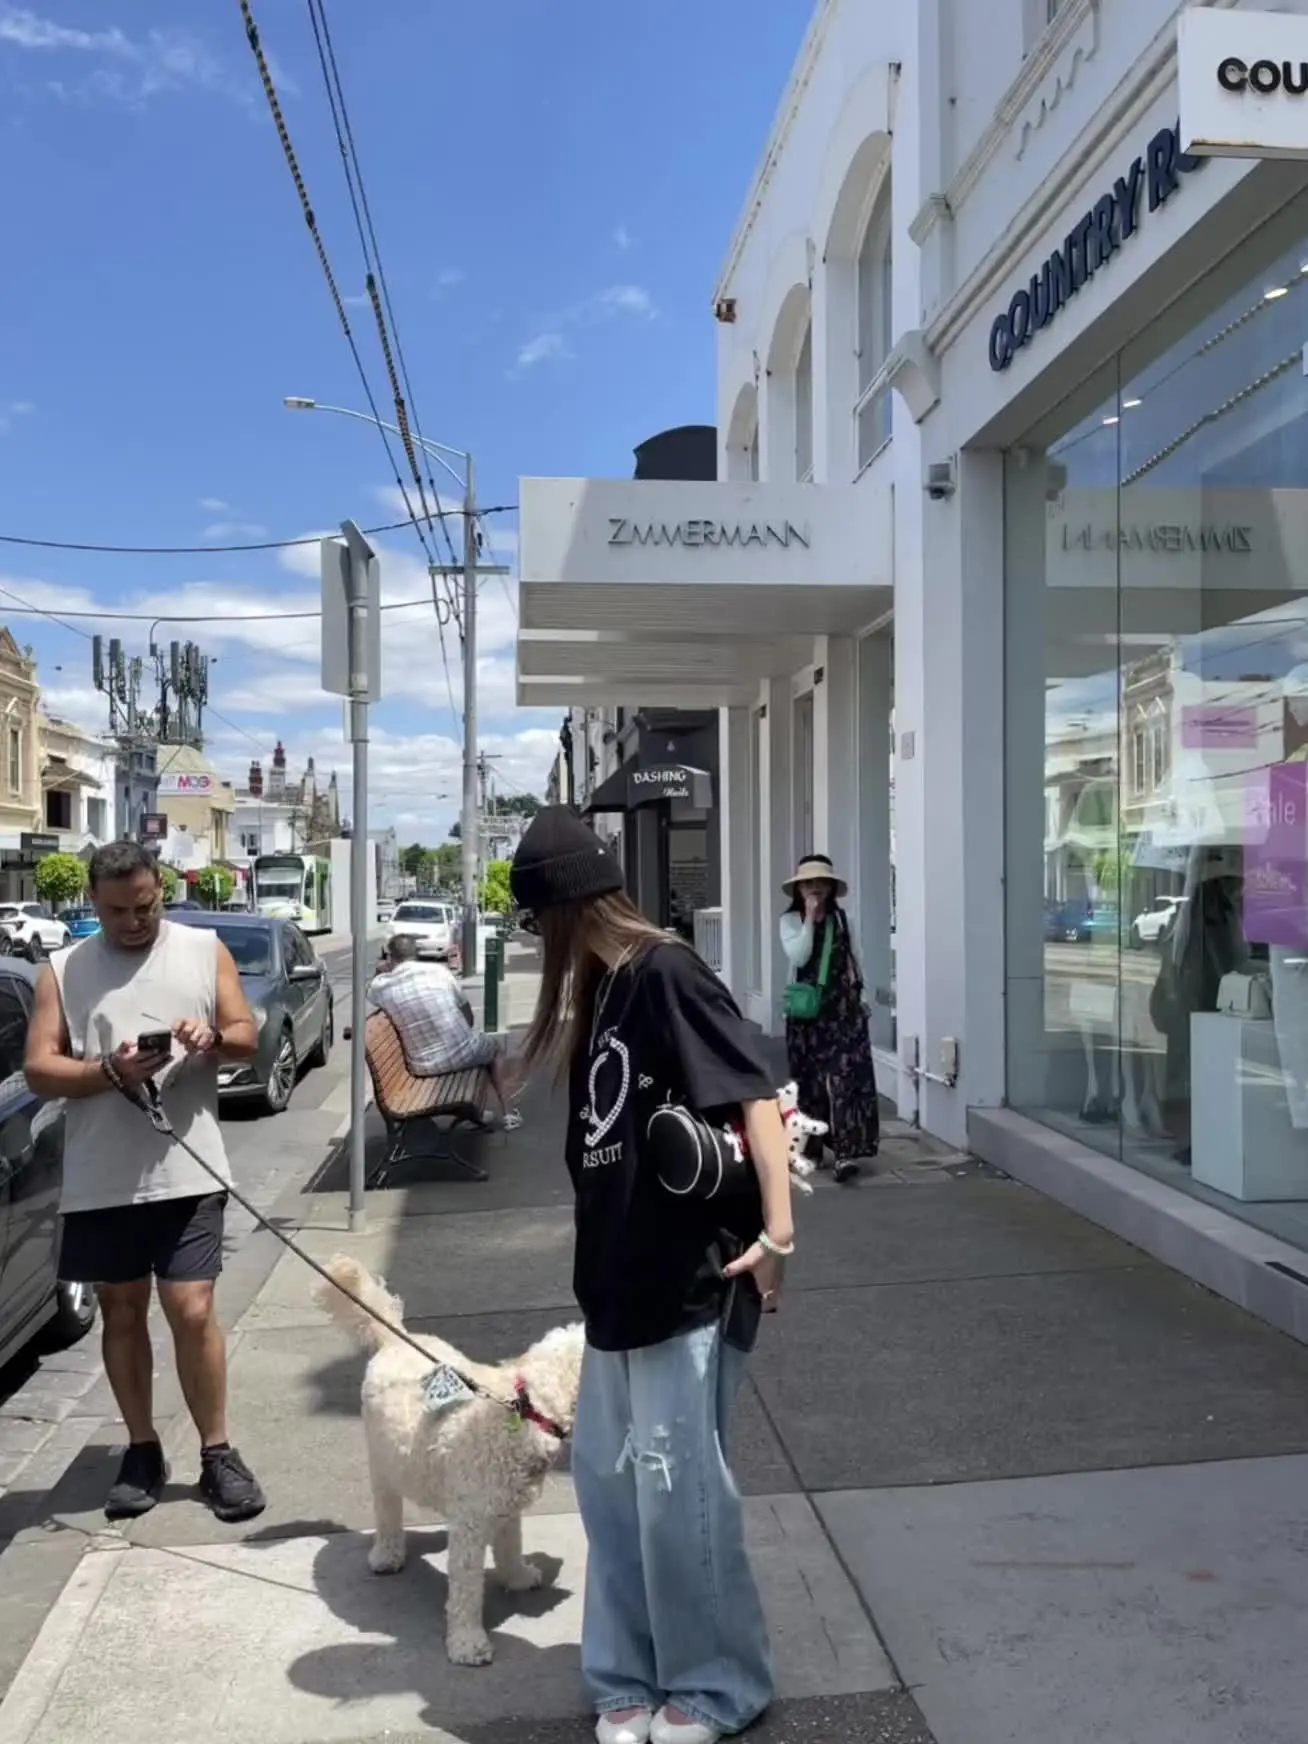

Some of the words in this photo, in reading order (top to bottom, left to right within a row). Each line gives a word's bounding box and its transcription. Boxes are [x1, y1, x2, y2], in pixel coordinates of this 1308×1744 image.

[1217, 57, 1308, 94] COU
[989, 156, 1144, 372] COUNTRY
[607, 517, 810, 549] ZMMERMANN
[632, 769, 687, 785] DASHING
